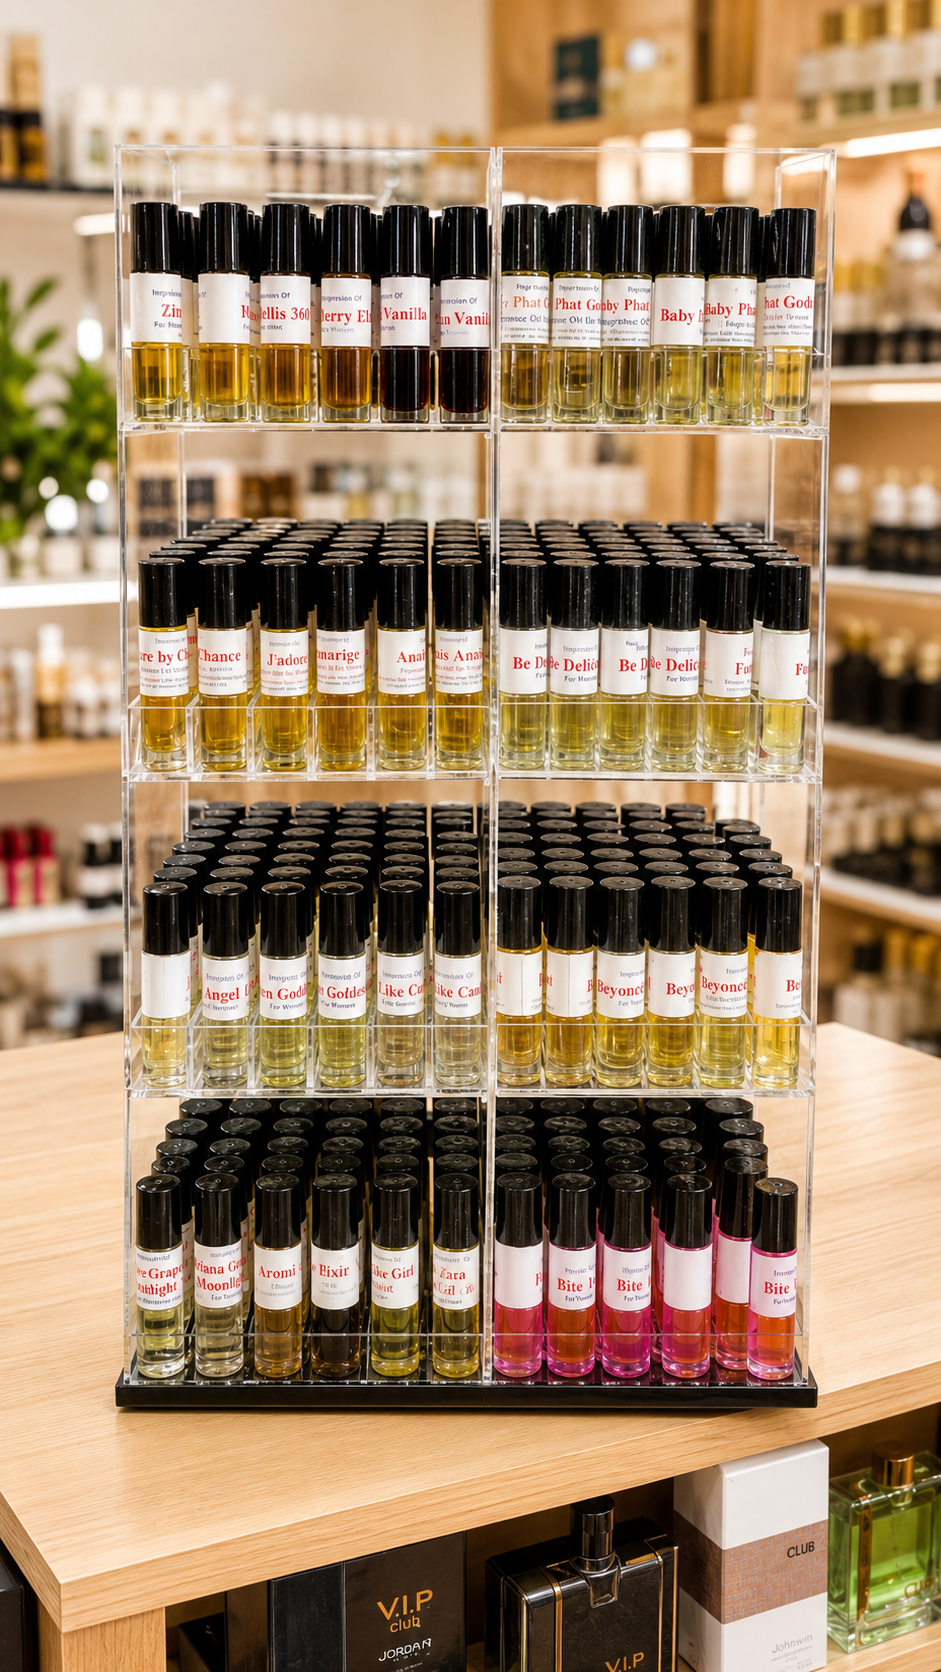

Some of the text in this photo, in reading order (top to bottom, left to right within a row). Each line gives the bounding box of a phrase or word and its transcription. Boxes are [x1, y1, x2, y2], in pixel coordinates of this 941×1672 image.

[290, 307, 310, 320] 360
[661, 308, 695, 326] Baby
[158, 650, 174, 665] by
[513, 656, 531, 670] Be
[619, 658, 637, 672] Be
[204, 987, 240, 1003] Angel
[557, 1276, 583, 1293] Bite
[617, 1278, 643, 1292] Bite
[787, 1541, 815, 1559] CLUB
[376, 1588, 434, 1621] V.I.P
[389, 1614, 421, 1634] club
[771, 1633, 813, 1654] Johnwin
